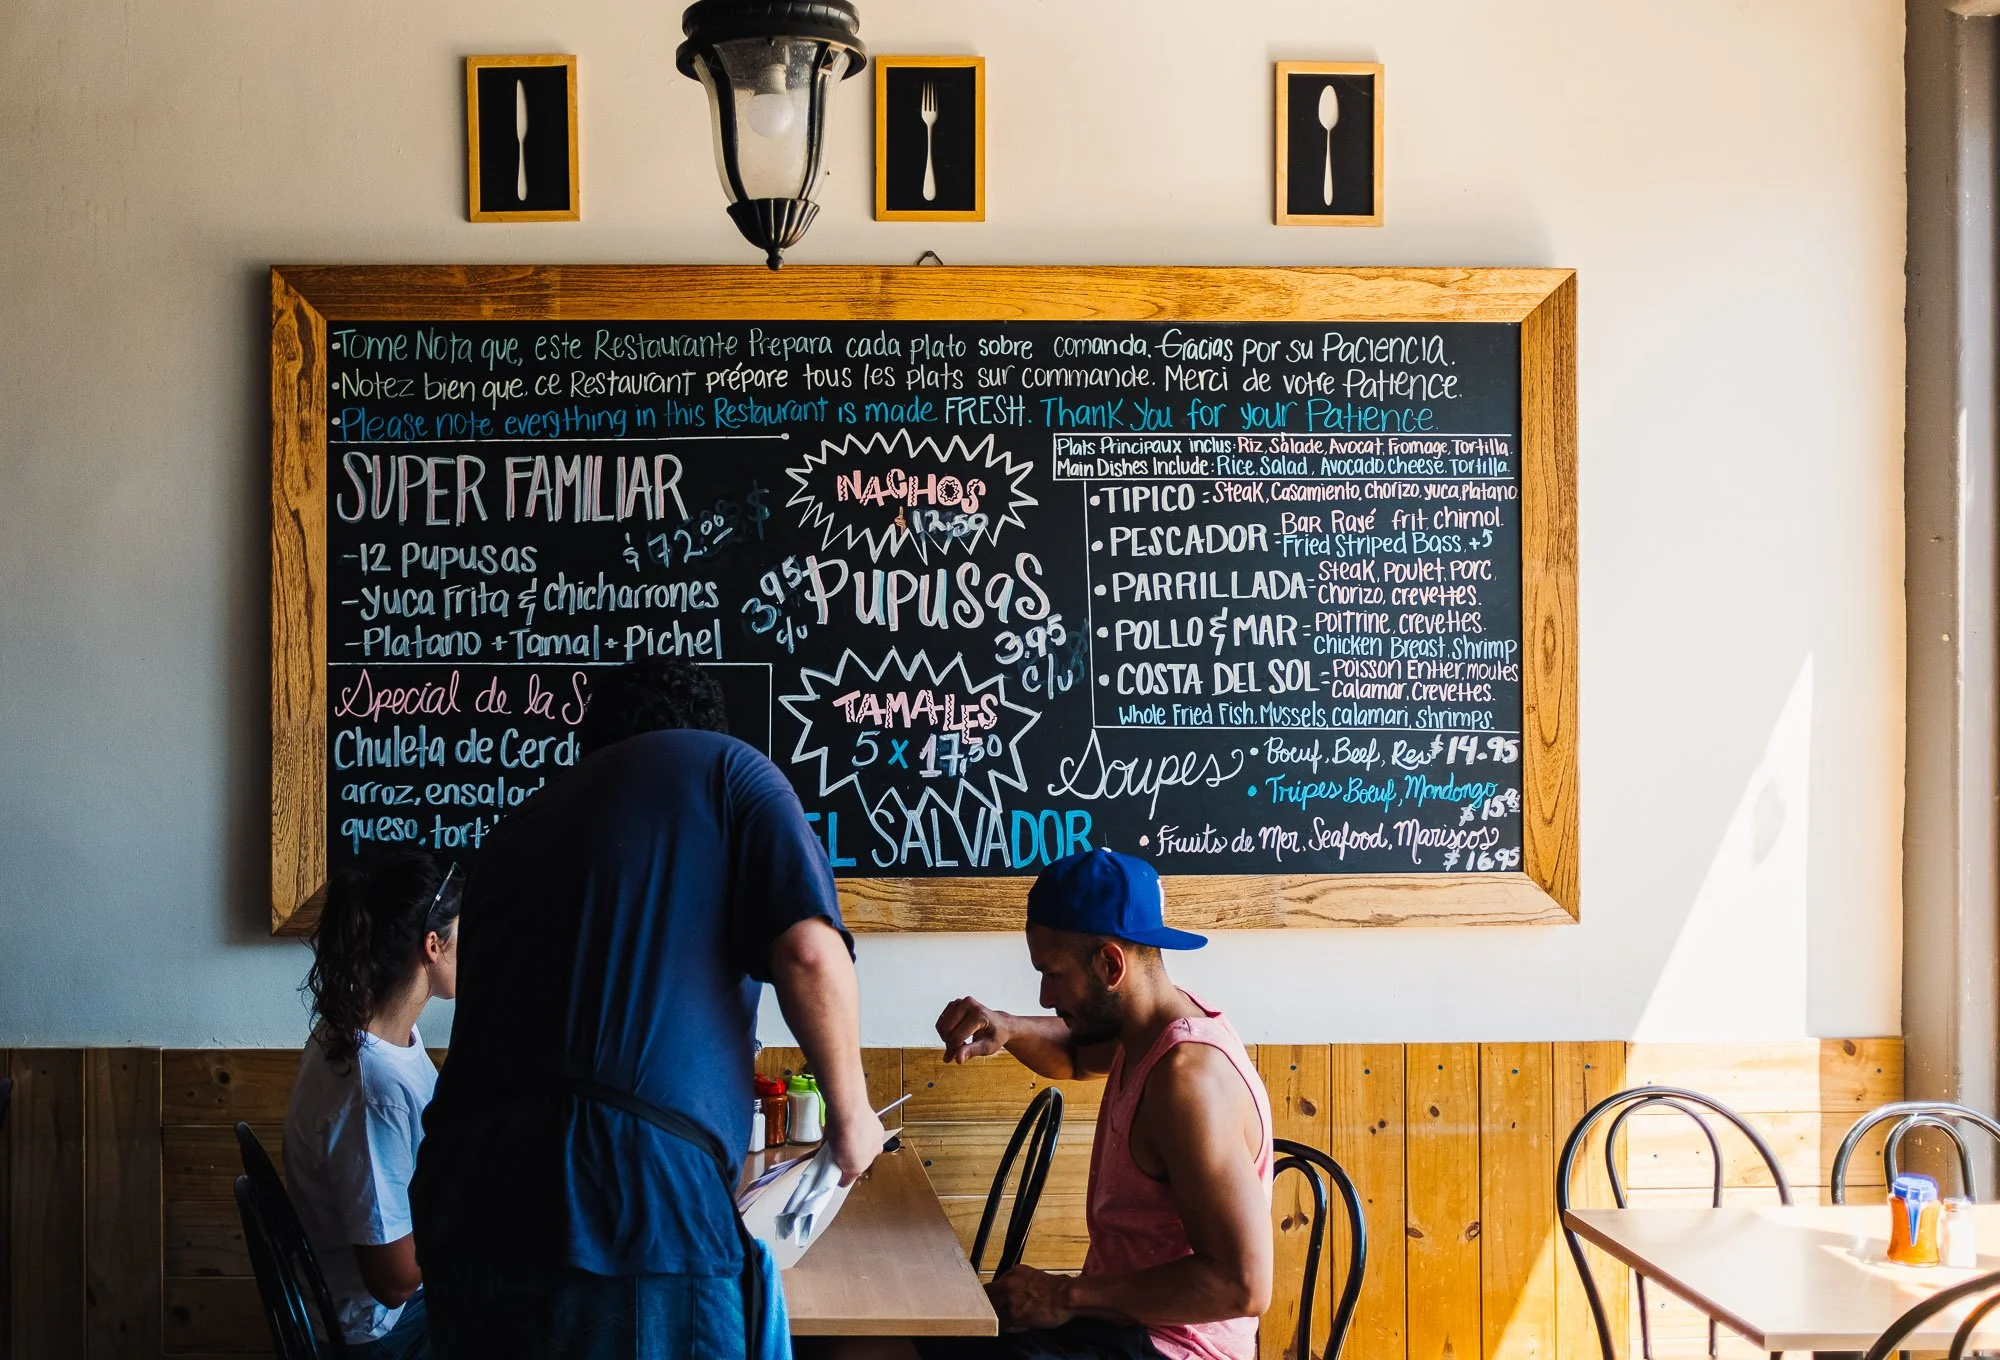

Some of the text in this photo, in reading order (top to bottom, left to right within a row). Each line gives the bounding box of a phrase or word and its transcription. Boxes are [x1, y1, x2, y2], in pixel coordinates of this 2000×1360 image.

[332, 329, 407, 361] Tome
[416, 328, 472, 363] Nota
[535, 333, 581, 360] este
[595, 329, 737, 360] Restaurante
[749, 328, 832, 361] Prepara
[846, 330, 901, 358] cada
[910, 334, 966, 365] plato
[978, 335, 1032, 359] sobre
[1054, 333, 1151, 358] comanda.
[1242, 339, 1281, 367] por
[1286, 340, 1313, 363] su
[1322, 332, 1455, 366] Paciencia.
[342, 368, 414, 399] Notez
[424, 372, 475, 402] bien
[535, 374, 562, 395] ce
[706, 362, 788, 393] prépare
[802, 363, 852, 390] tous
[864, 363, 895, 390] les
[906, 362, 963, 390] plats
[978, 365, 1015, 388] sur
[1022, 365, 1155, 388] commande.
[1165, 364, 1228, 391] Merci
[1243, 368, 1271, 392] de
[1283, 372, 1335, 397] votre
[1342, 369, 1462, 401] Patience.
[341, 407, 428, 440] Please
[437, 411, 493, 439] note
[505, 405, 626, 438] everything
[637, 408, 656, 428] in
[667, 400, 705, 426] this
[838, 402, 856, 424] is
[865, 400, 938, 424] made
[946, 394, 1032, 426] FRESH.
[1187, 398, 1226, 430] for
[1240, 402, 1298, 430] your
[1306, 398, 1438, 432] Patience.
[1056, 437, 1097, 456] Plats
[1099, 436, 1182, 456] Principaux
[1237, 436, 1268, 455] Riz,
[1388, 437, 1451, 460] Fromage,
[1451, 437, 1513, 458] Tortilla.
[1056, 457, 1094, 477] Main
[1097, 458, 1149, 477] Dishes
[1153, 455, 1214, 476] Include:
[1260, 455, 1314, 476] Salad,
[1447, 457, 1512, 476] Tortilla.
[337, 452, 488, 527] SUPER
[505, 454, 693, 523] FAMILIAR
[836, 468, 987, 514] NACHOS
[1099, 483, 1195, 513] TIPICO
[1331, 508, 1377, 533] Rayé
[1110, 524, 1268, 556] PESCADOR
[1283, 534, 1331, 558] Fried
[1335, 532, 1408, 557] Striped
[1412, 532, 1466, 554] Bass,
[544, 571, 719, 615] chicharrones
[1112, 570, 1308, 602] PARRILLADA
[509, 625, 599, 660] Tamal
[624, 619, 722, 661] Pichel
[1115, 616, 1203, 651] POLLO
[1233, 614, 1297, 647] MAR
[1315, 608, 1396, 635] Poitrine,
[1390, 636, 1451, 661] Breast,
[1117, 658, 1320, 696] COSTA DEL SOL
[1332, 658, 1401, 681] Poisson
[1466, 660, 1518, 682] moules
[335, 669, 461, 723] Special
[475, 676, 512, 714] de
[524, 674, 555, 719] la
[1119, 704, 1166, 725] Whole
[1172, 704, 1214, 725] Fried
[1219, 701, 1257, 725] Fish,
[1259, 701, 1329, 728] Mussels,
[833, 690, 998, 745] TAMALES
[334, 724, 580, 770] Chuleta de Cerd
[852, 730, 880, 767] 5
[1332, 737, 1385, 771] Beef,
[341, 781, 421, 805] arroz,
[1047, 729, 1244, 820] Soupes
[1265, 773, 1343, 811] Tripes
[1404, 772, 1499, 809] Mondongo
[341, 816, 426, 854] queso,
[871, 806, 1093, 868] SALVADOR
[1156, 817, 1500, 865] Fruits de Mer, Seafood, Mariscos
